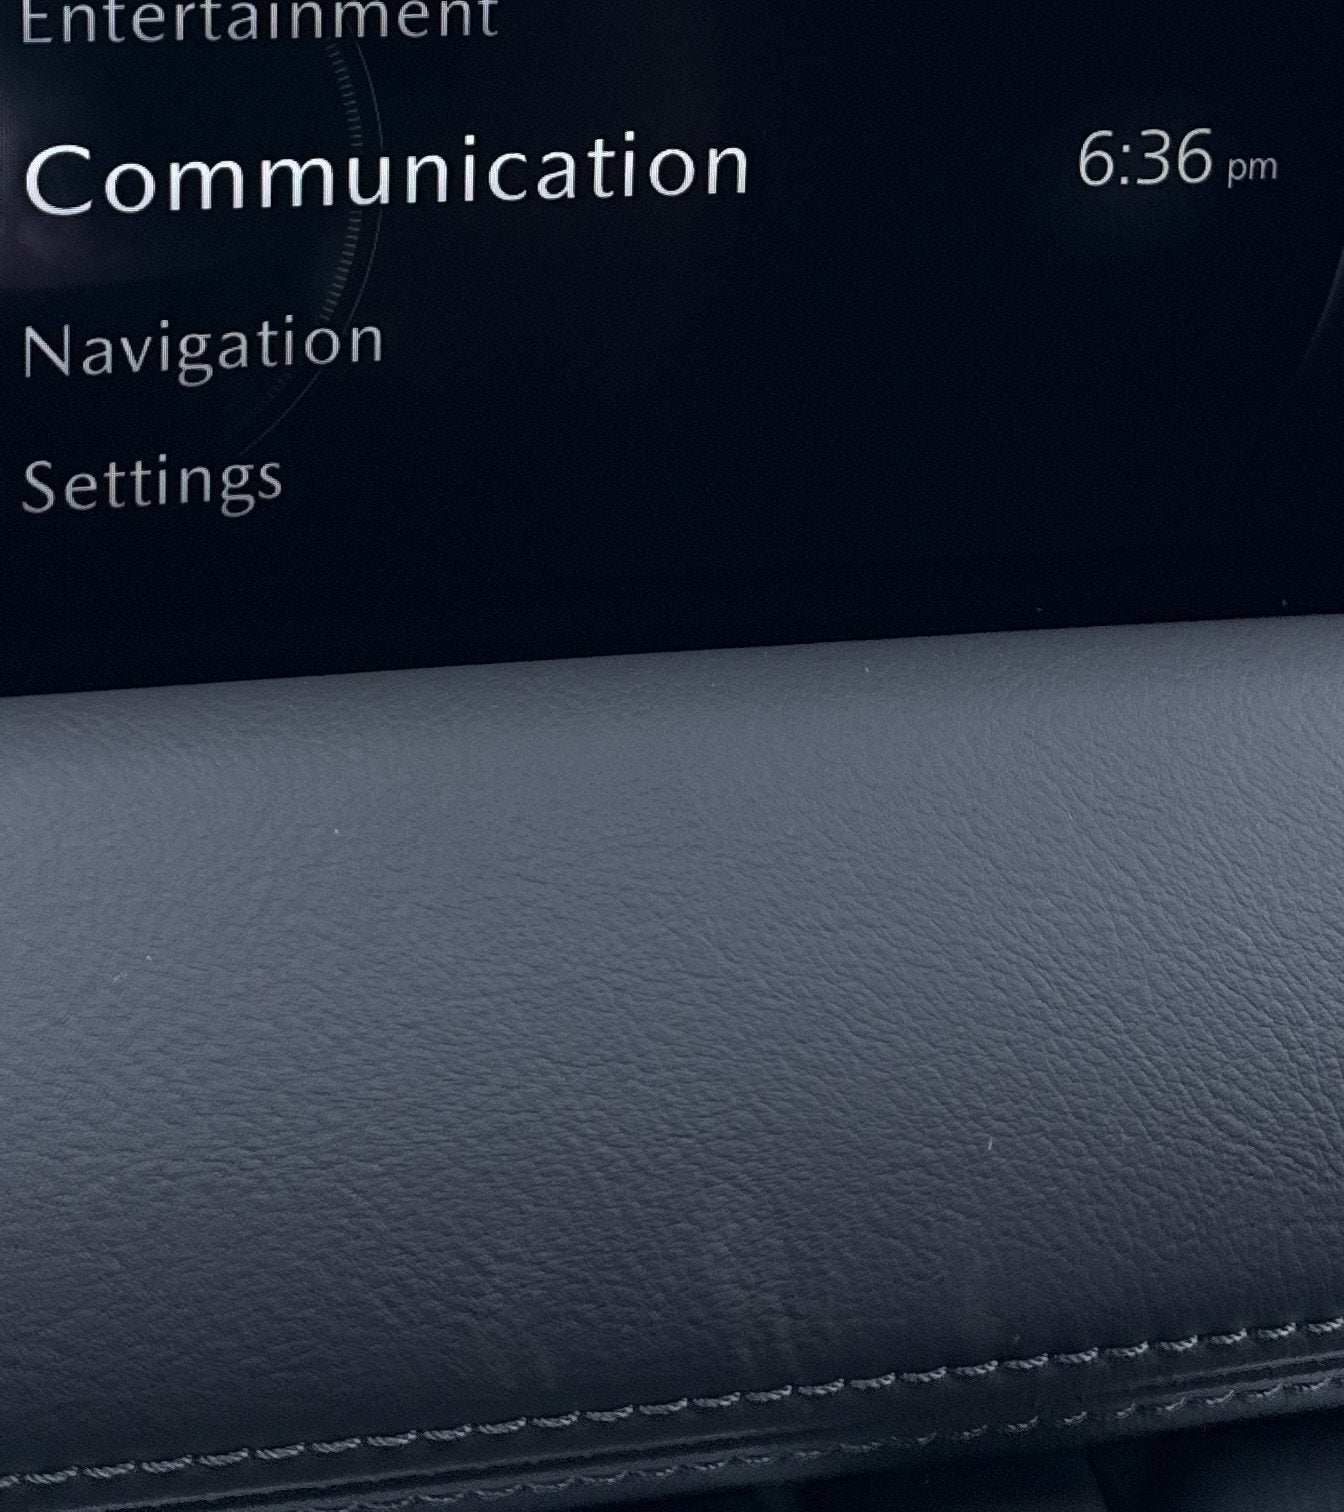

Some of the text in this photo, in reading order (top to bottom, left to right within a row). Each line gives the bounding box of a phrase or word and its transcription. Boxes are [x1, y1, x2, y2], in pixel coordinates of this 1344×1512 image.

[25, 130, 747, 216] Communication
[1078, 127, 1278, 190] 6:36 pm
[24, 314, 382, 388] Navigation
[21, 453, 282, 518] Settings
